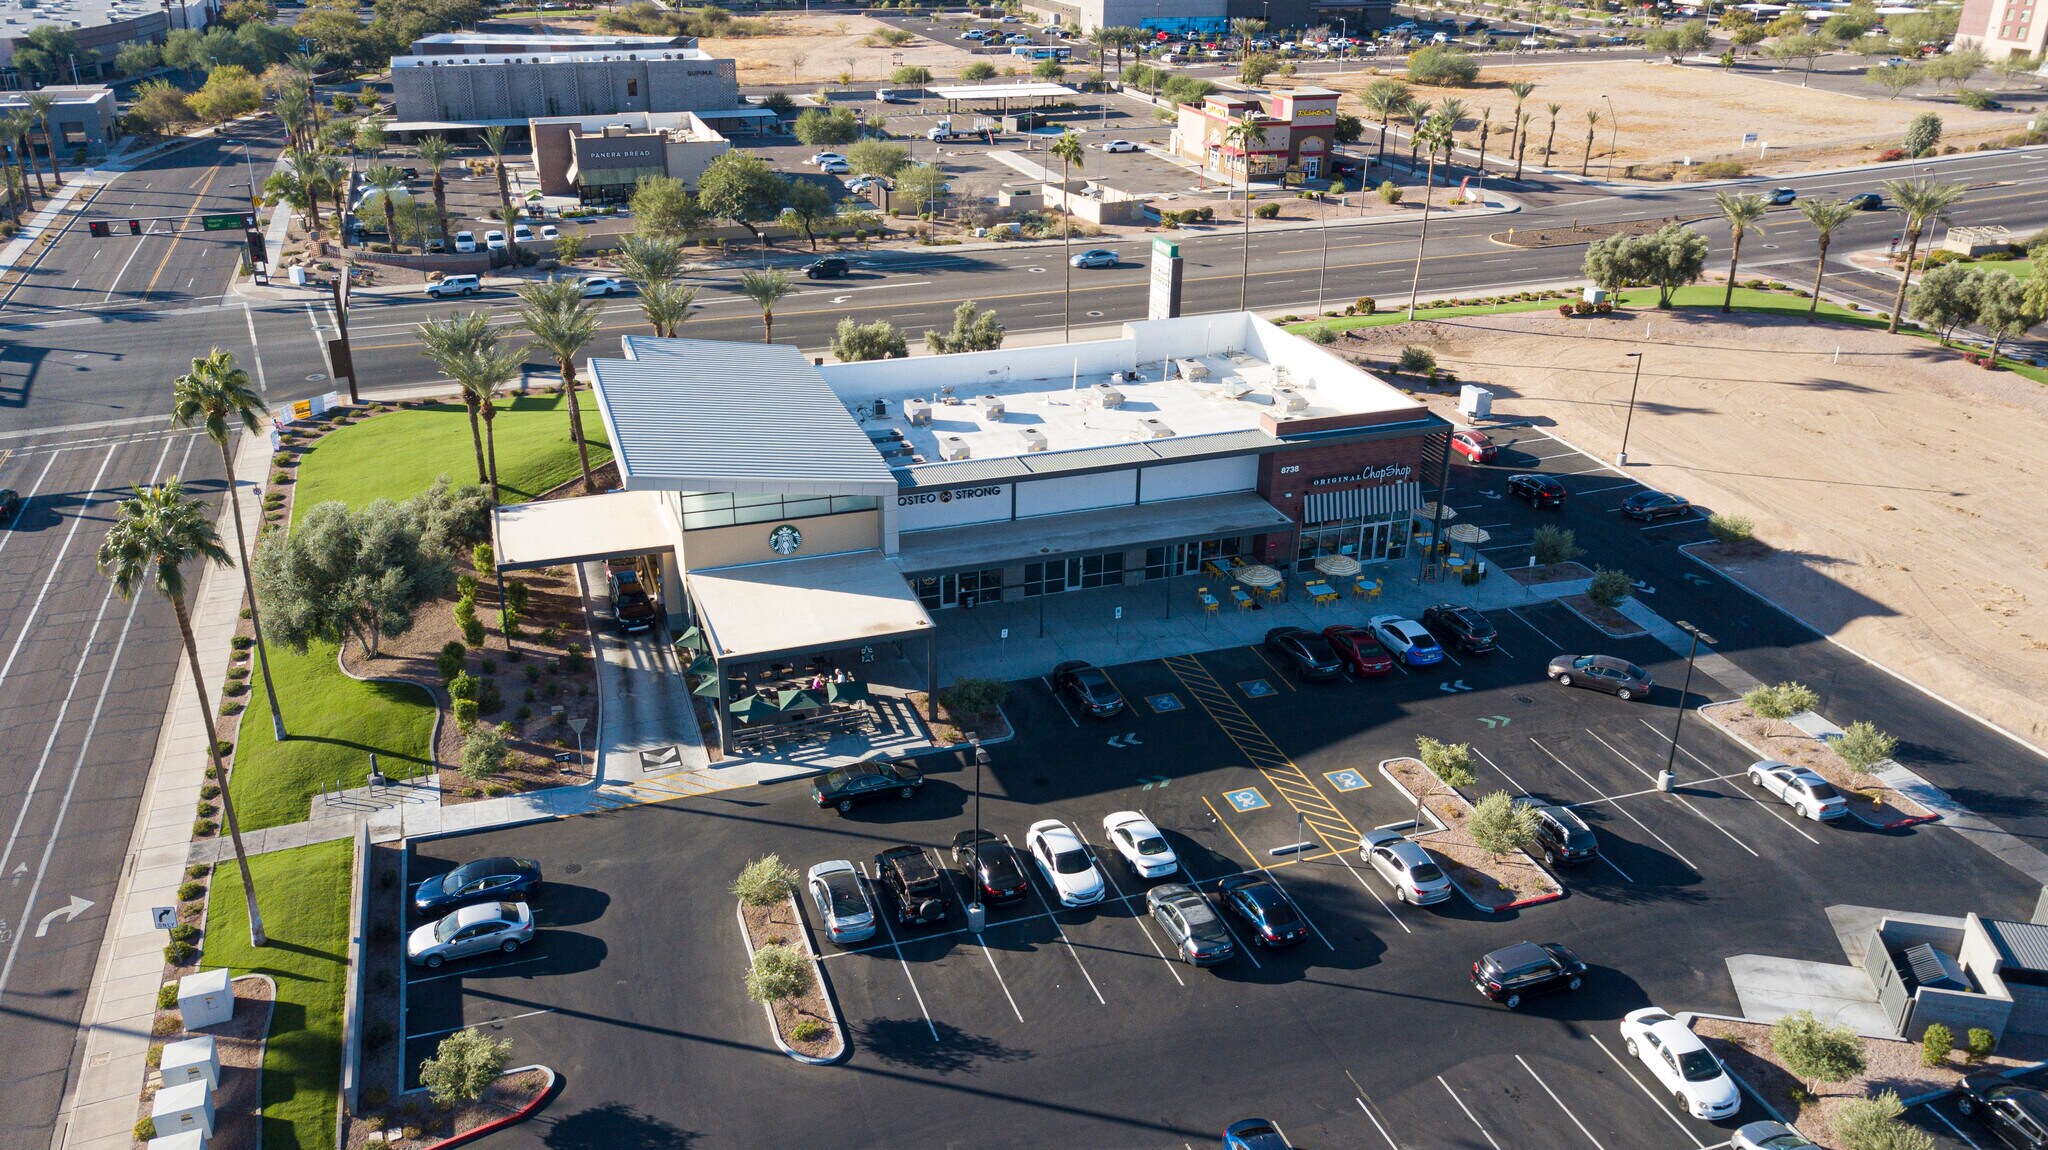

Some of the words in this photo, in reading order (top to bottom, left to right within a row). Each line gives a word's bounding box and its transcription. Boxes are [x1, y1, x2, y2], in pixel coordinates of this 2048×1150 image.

[1280, 465, 1300, 474] 8738
[1313, 475, 1362, 486] ORIGINAL
[897, 493, 937, 506] OSTEO
[955, 486, 1001, 500] STRONG
